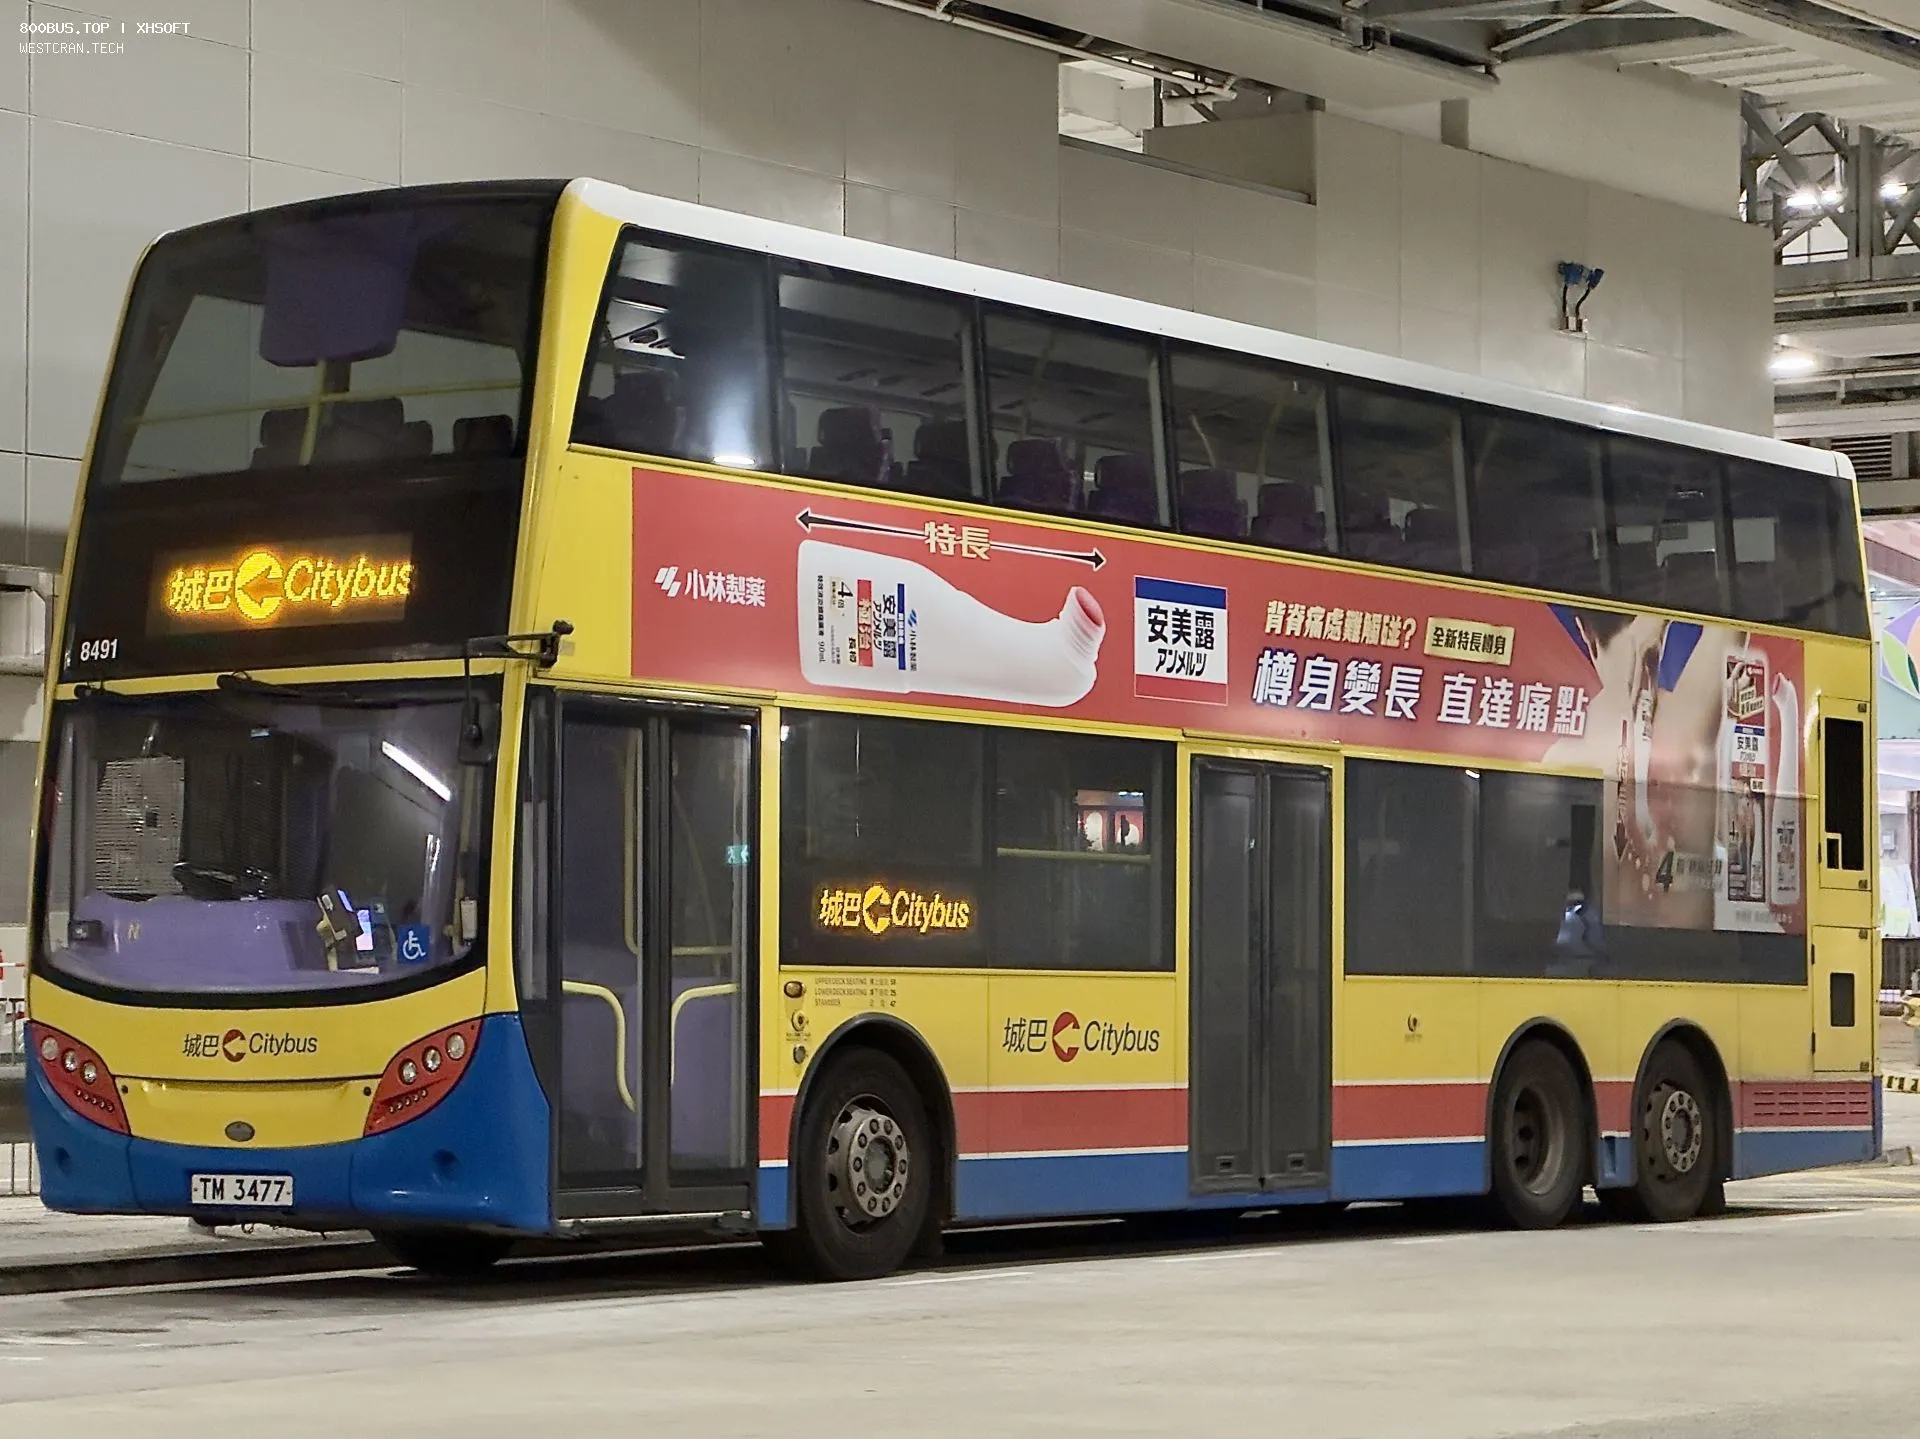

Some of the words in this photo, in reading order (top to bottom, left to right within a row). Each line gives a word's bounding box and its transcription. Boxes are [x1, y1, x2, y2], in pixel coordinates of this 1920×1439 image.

[924, 521, 991, 561] 特長
[169, 569, 234, 612] 城巴
[283, 557, 414, 608] Citybus
[1147, 604, 1215, 650] 安美露
[1431, 626, 1507, 655] 全新特長樽身
[80, 638, 118, 662] 8491
[1155, 648, 1208, 677] アンメルツ
[1252, 649, 1423, 721] 樽身變長
[1437, 672, 1590, 737] 直達痛點
[819, 889, 863, 927] 城巴
[890, 890, 970, 934] Citybus
[182, 1033, 219, 1058] 城巴
[249, 1033, 317, 1057] Citybus
[1002, 1017, 1048, 1053] 城巴
[1084, 1019, 1160, 1054] Citybus
[200, 1178, 224, 1201] TM
[233, 1179, 286, 1202] 3477
